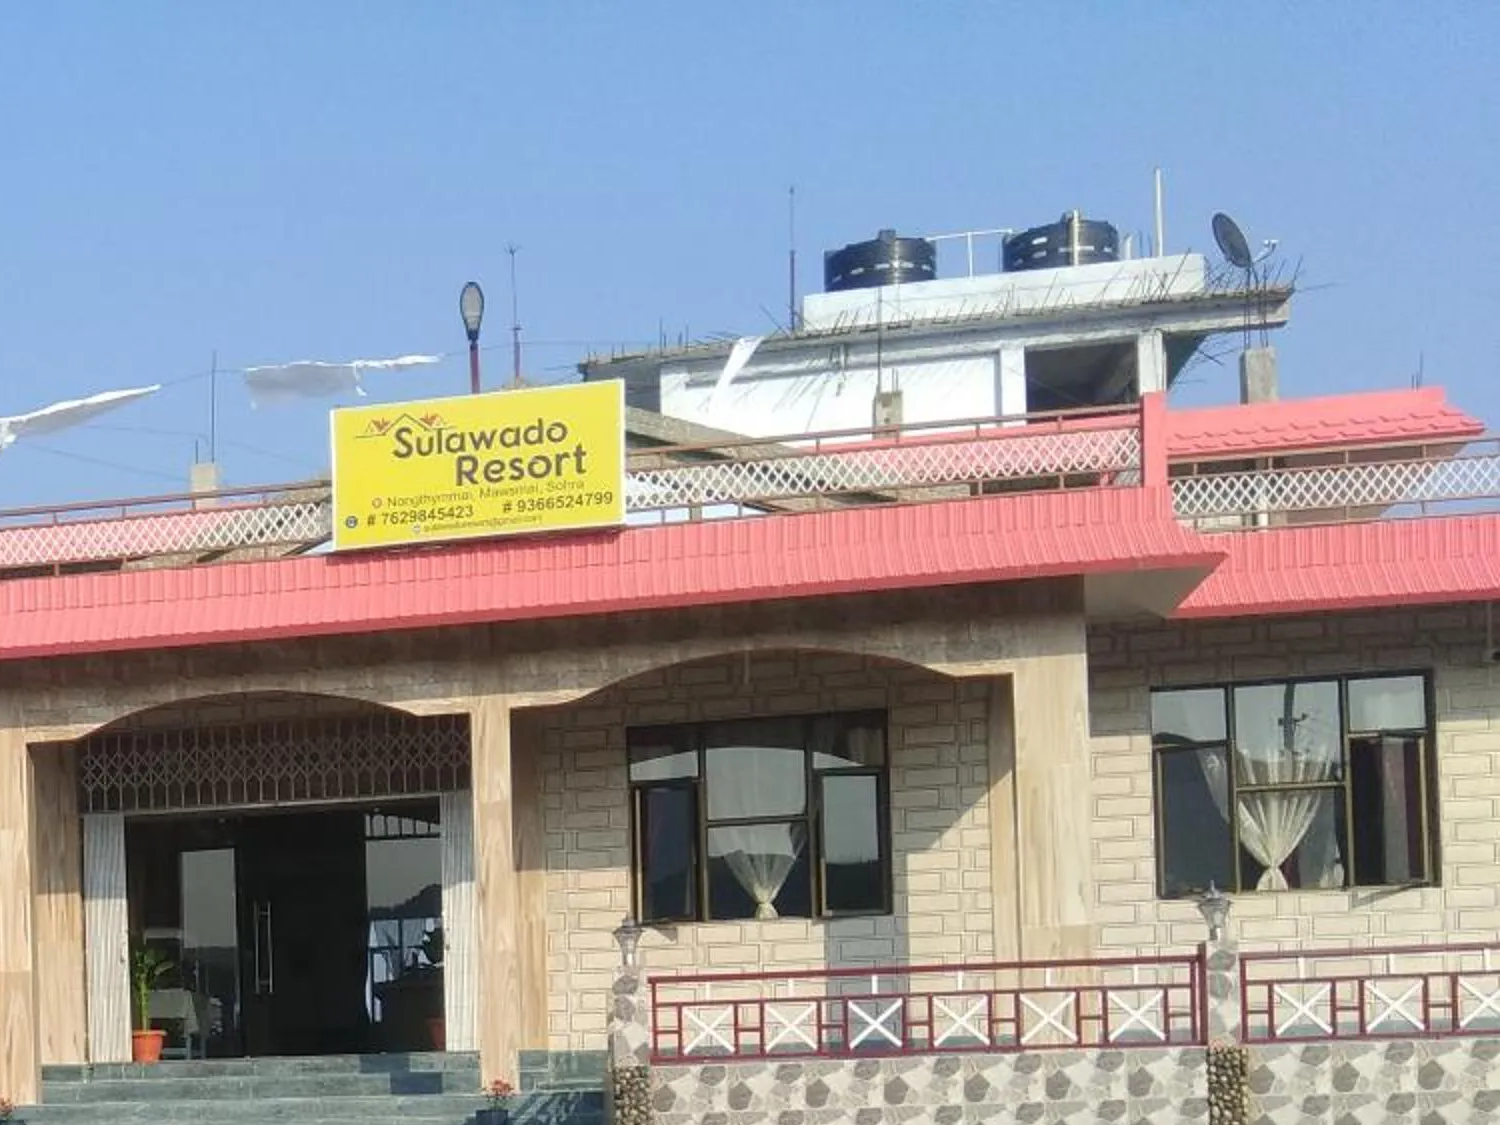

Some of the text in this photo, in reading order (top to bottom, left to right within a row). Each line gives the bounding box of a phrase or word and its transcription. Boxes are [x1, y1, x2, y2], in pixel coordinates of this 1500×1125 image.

[392, 417, 569, 459] Sulawado
[455, 443, 587, 487] Resort
[381, 504, 474, 526] 7629845423
[517, 491, 613, 514] 9366524799
